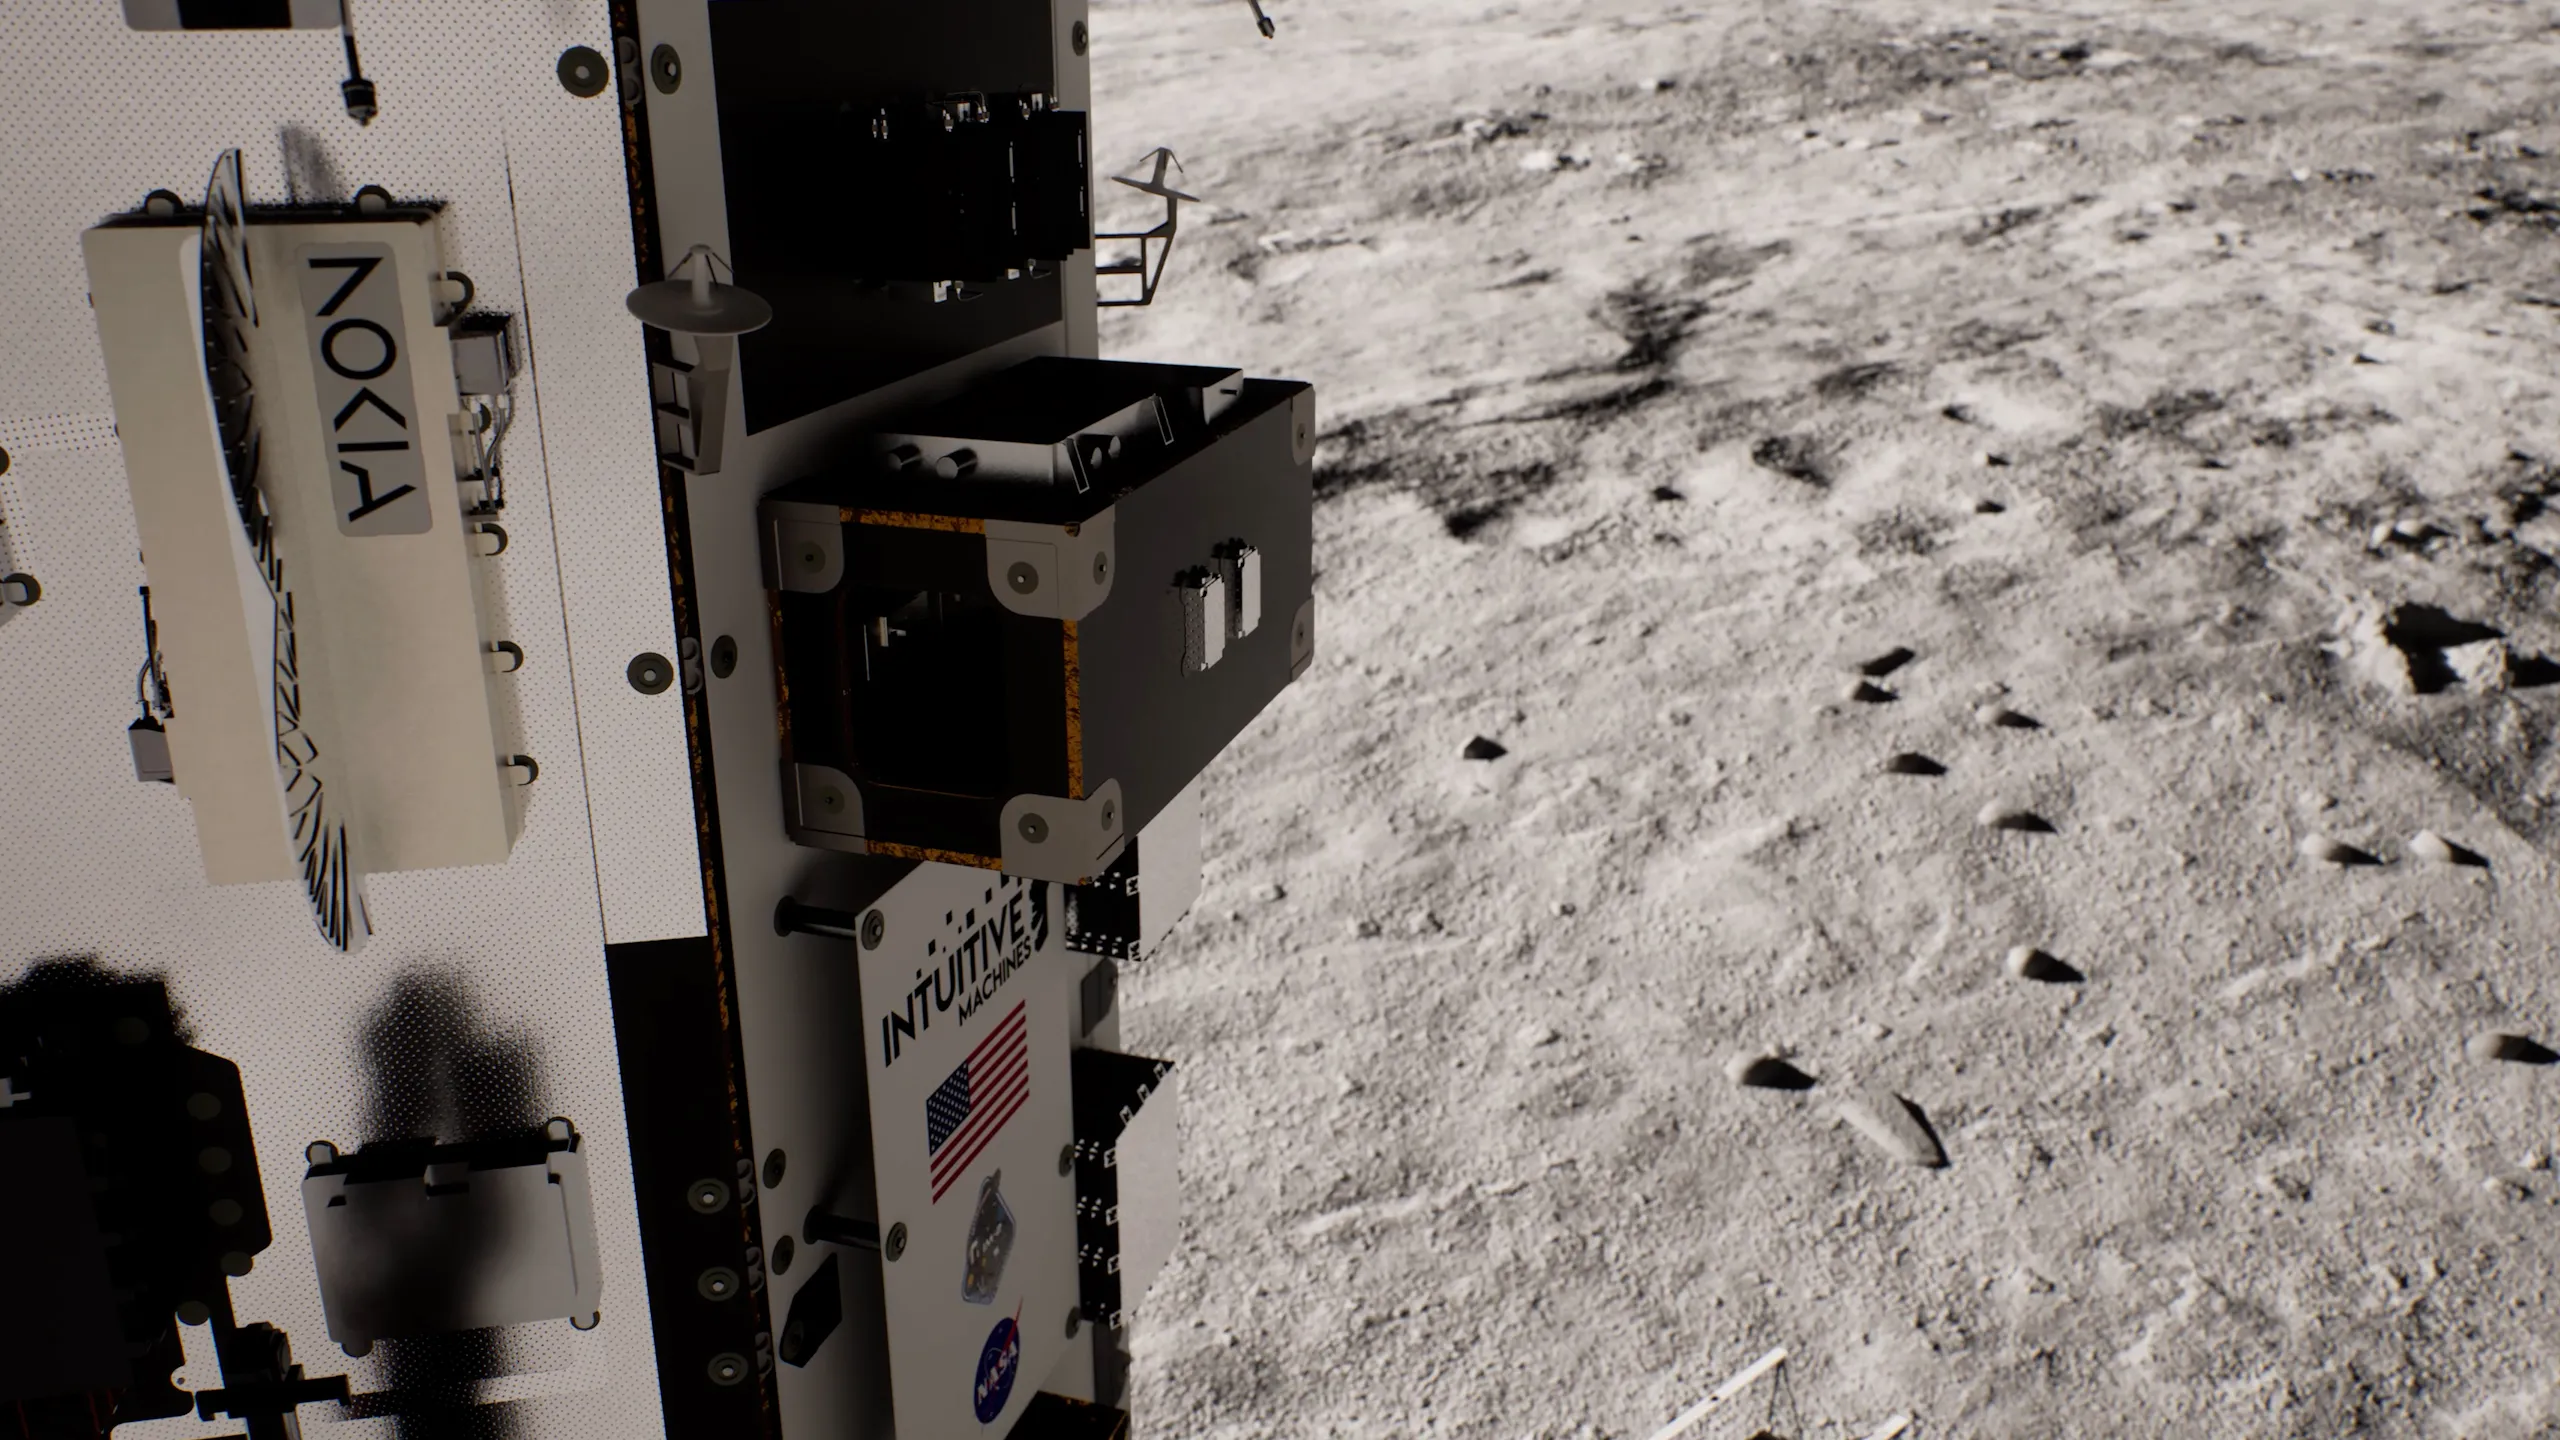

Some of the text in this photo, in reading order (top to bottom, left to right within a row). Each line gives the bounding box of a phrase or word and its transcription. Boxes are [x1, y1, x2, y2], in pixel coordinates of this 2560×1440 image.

[307, 256, 418, 523] NOKIA
[882, 889, 1026, 1069] INTUITIVE
[957, 935, 1032, 1027] MACHINES
[977, 1340, 1018, 1405] NASA
